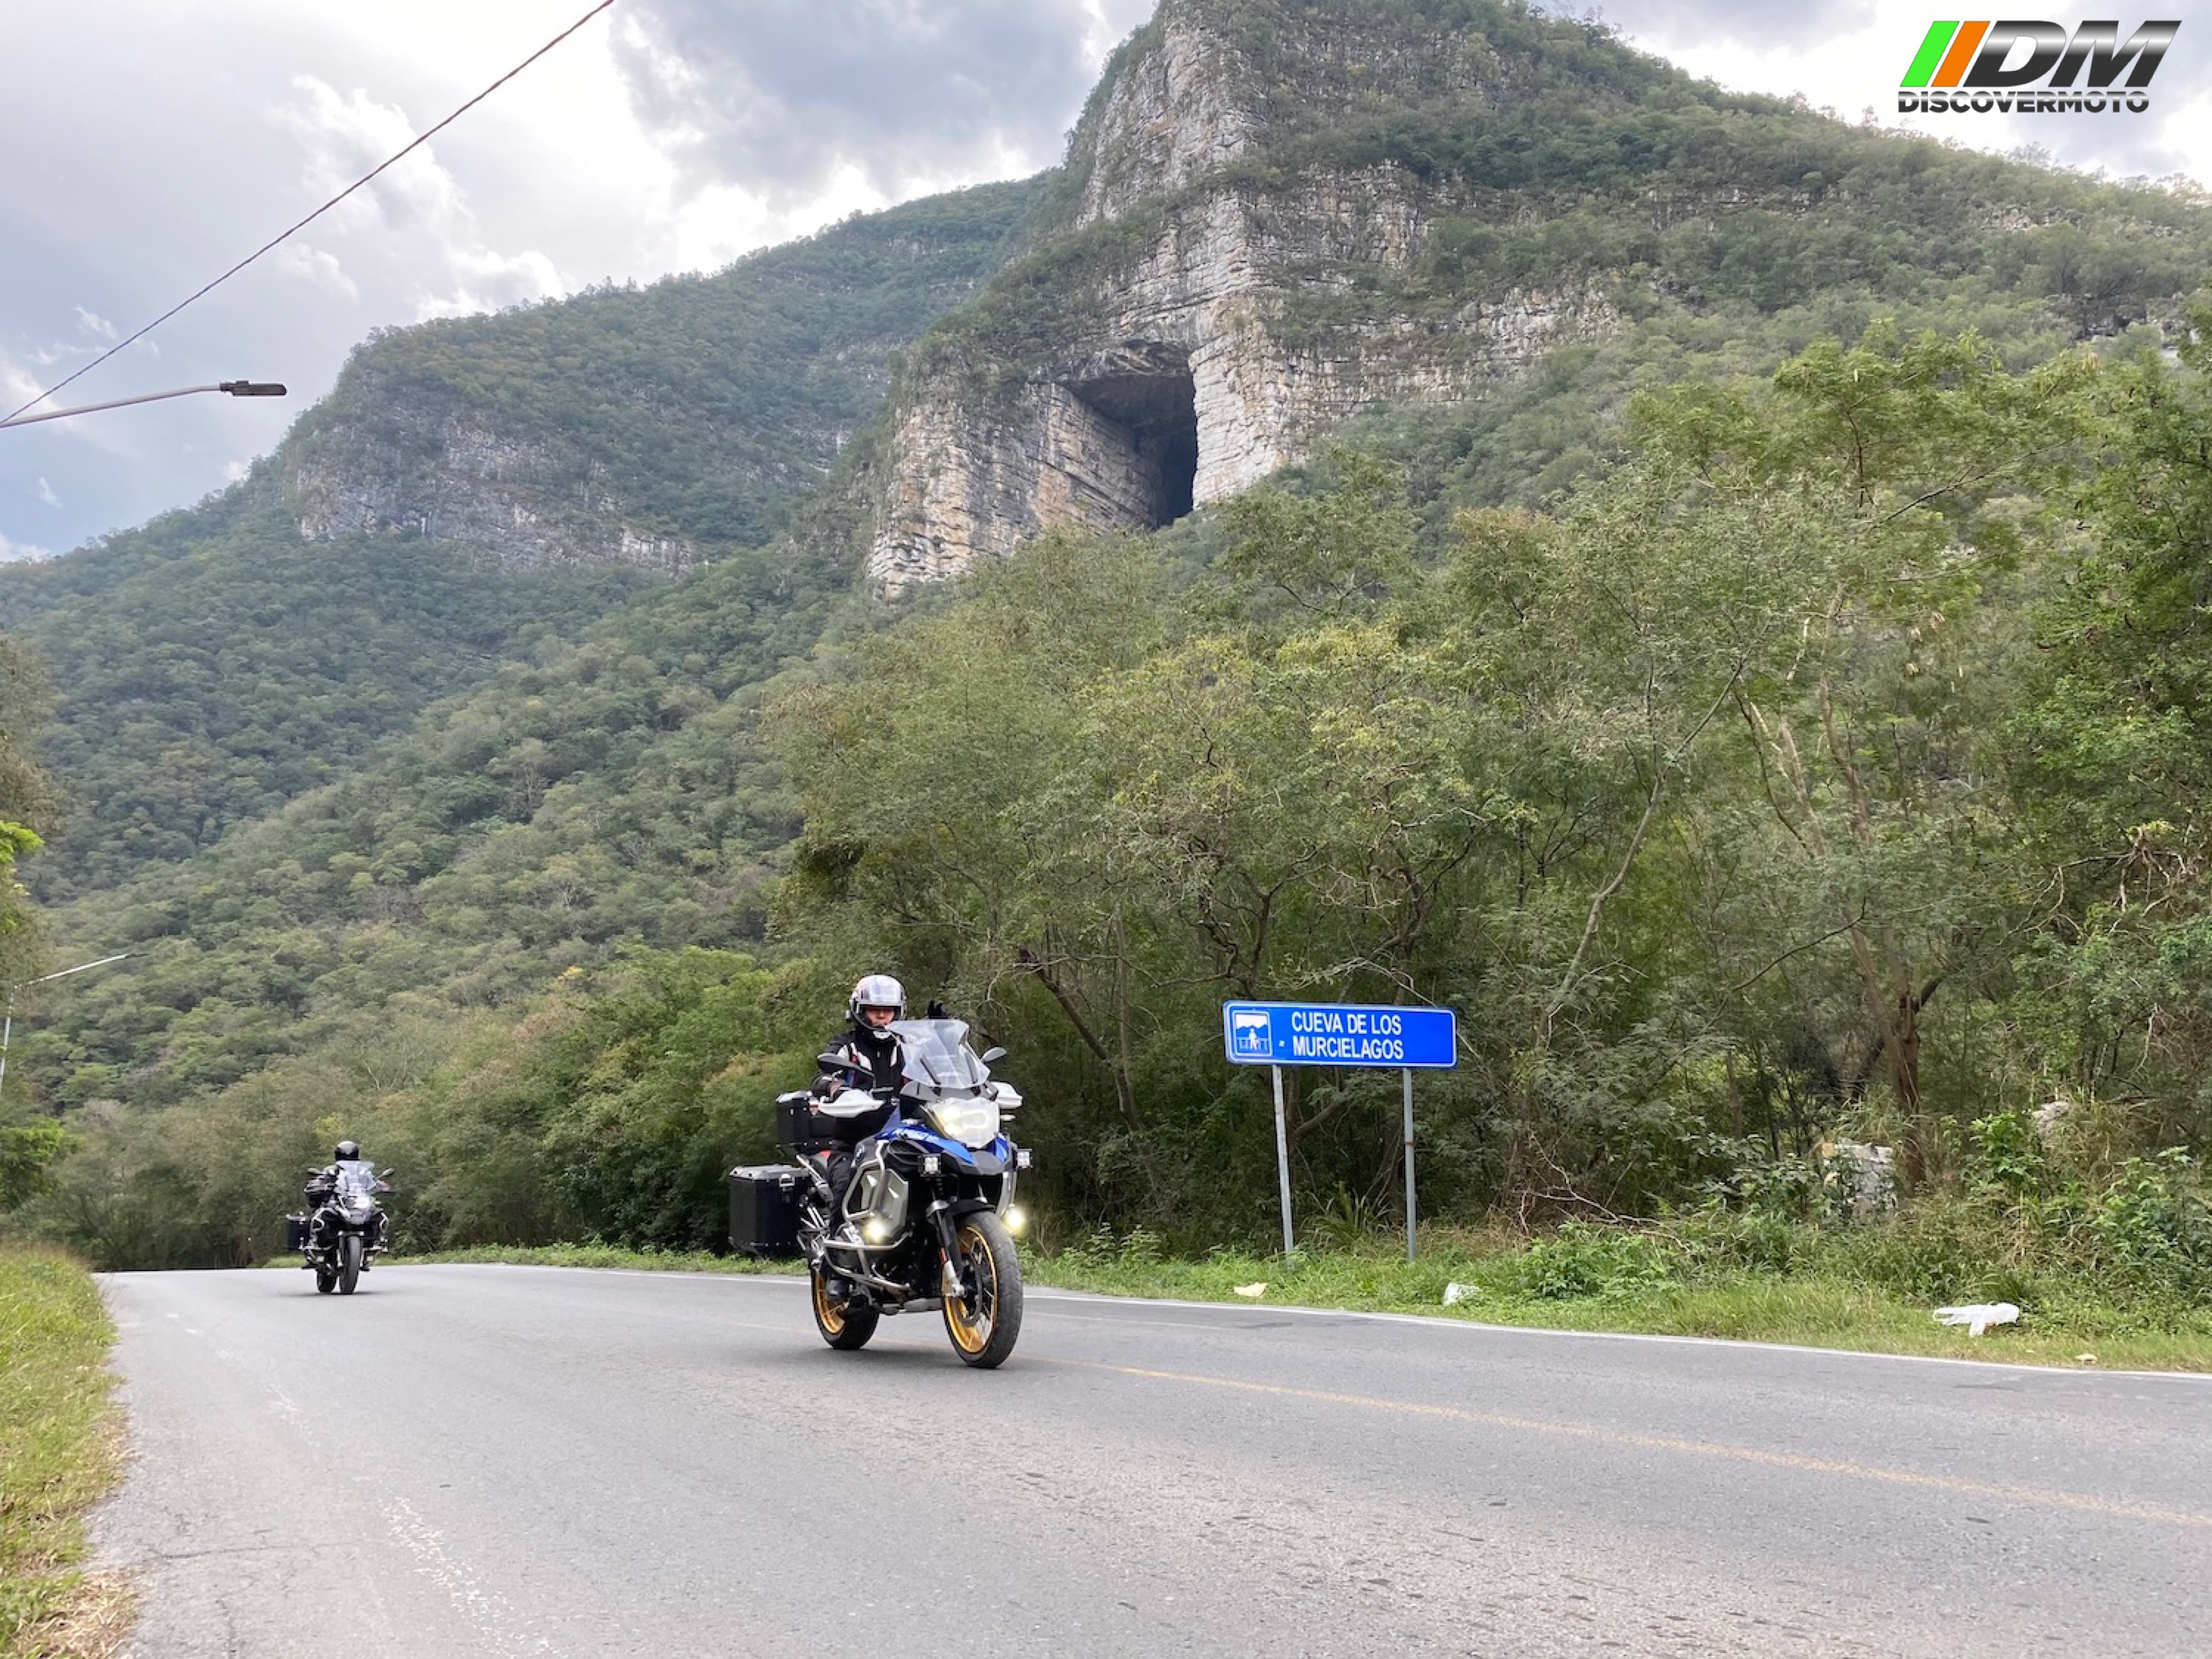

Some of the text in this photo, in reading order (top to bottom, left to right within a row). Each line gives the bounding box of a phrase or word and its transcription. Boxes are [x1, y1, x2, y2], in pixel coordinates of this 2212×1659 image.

[1291, 1011, 1402, 1034] CUEVA DE LOS
[1293, 1035, 1404, 1060] MURCIELAGOS
